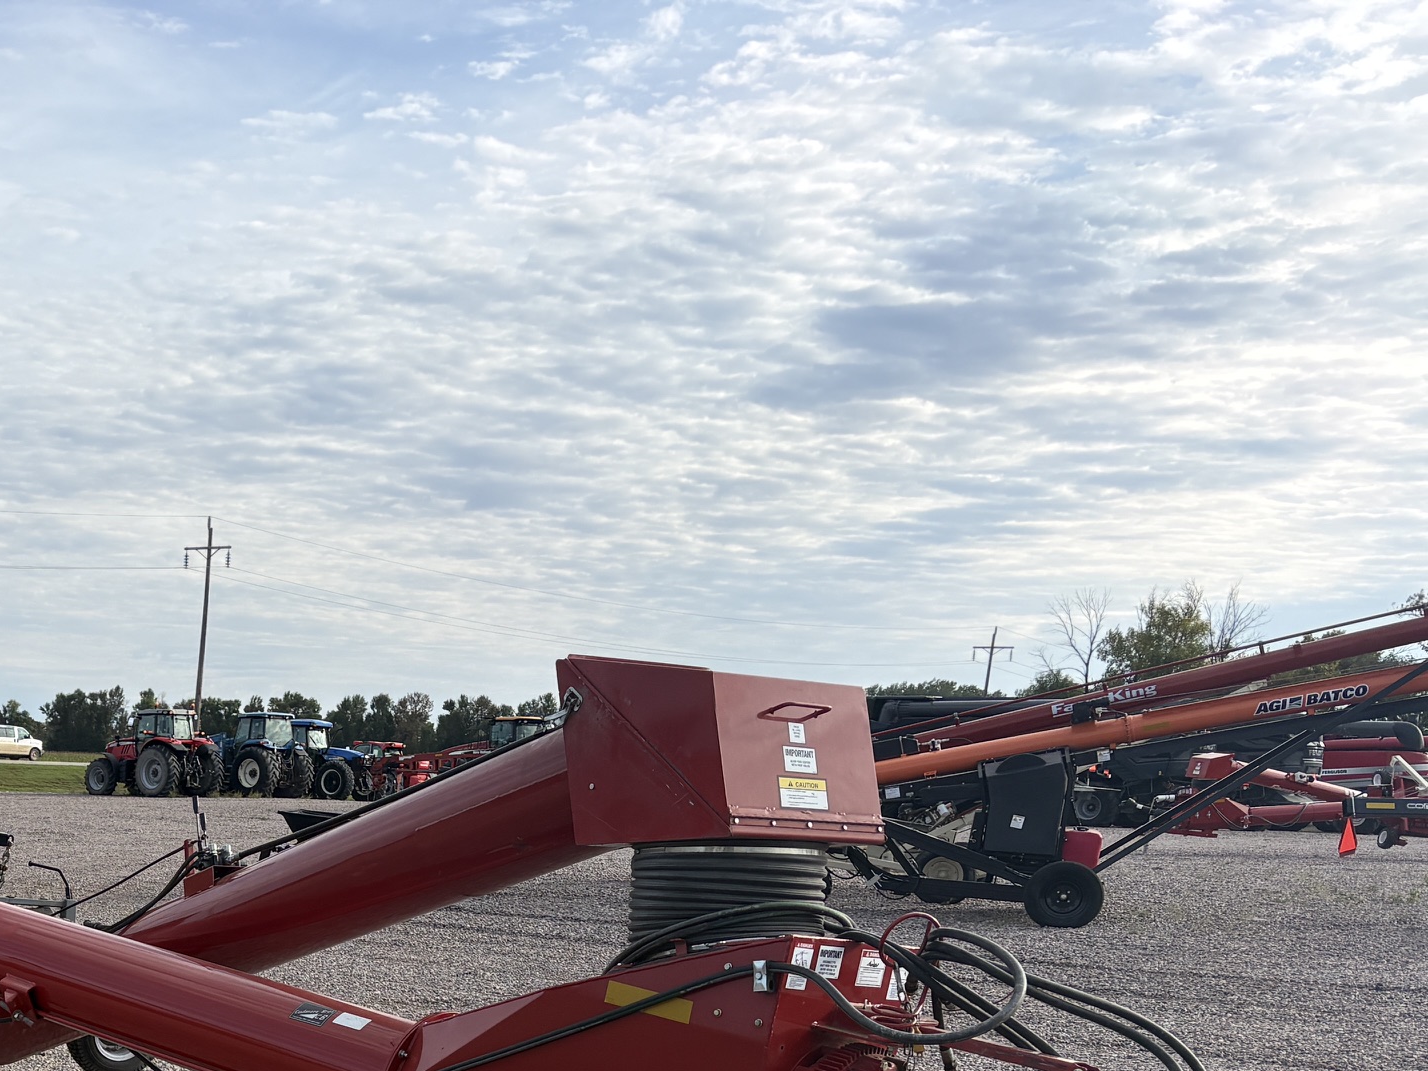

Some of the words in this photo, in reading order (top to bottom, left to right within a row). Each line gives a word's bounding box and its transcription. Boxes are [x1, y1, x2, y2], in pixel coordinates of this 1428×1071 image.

[1108, 684, 1157, 702] King
[1254, 699, 1288, 715] AGI
[1305, 684, 1369, 707] BATCO
[785, 748, 814, 759] IMPORTANT
[795, 781, 819, 789] CAUTION
[820, 949, 843, 959] IMPORTANT
